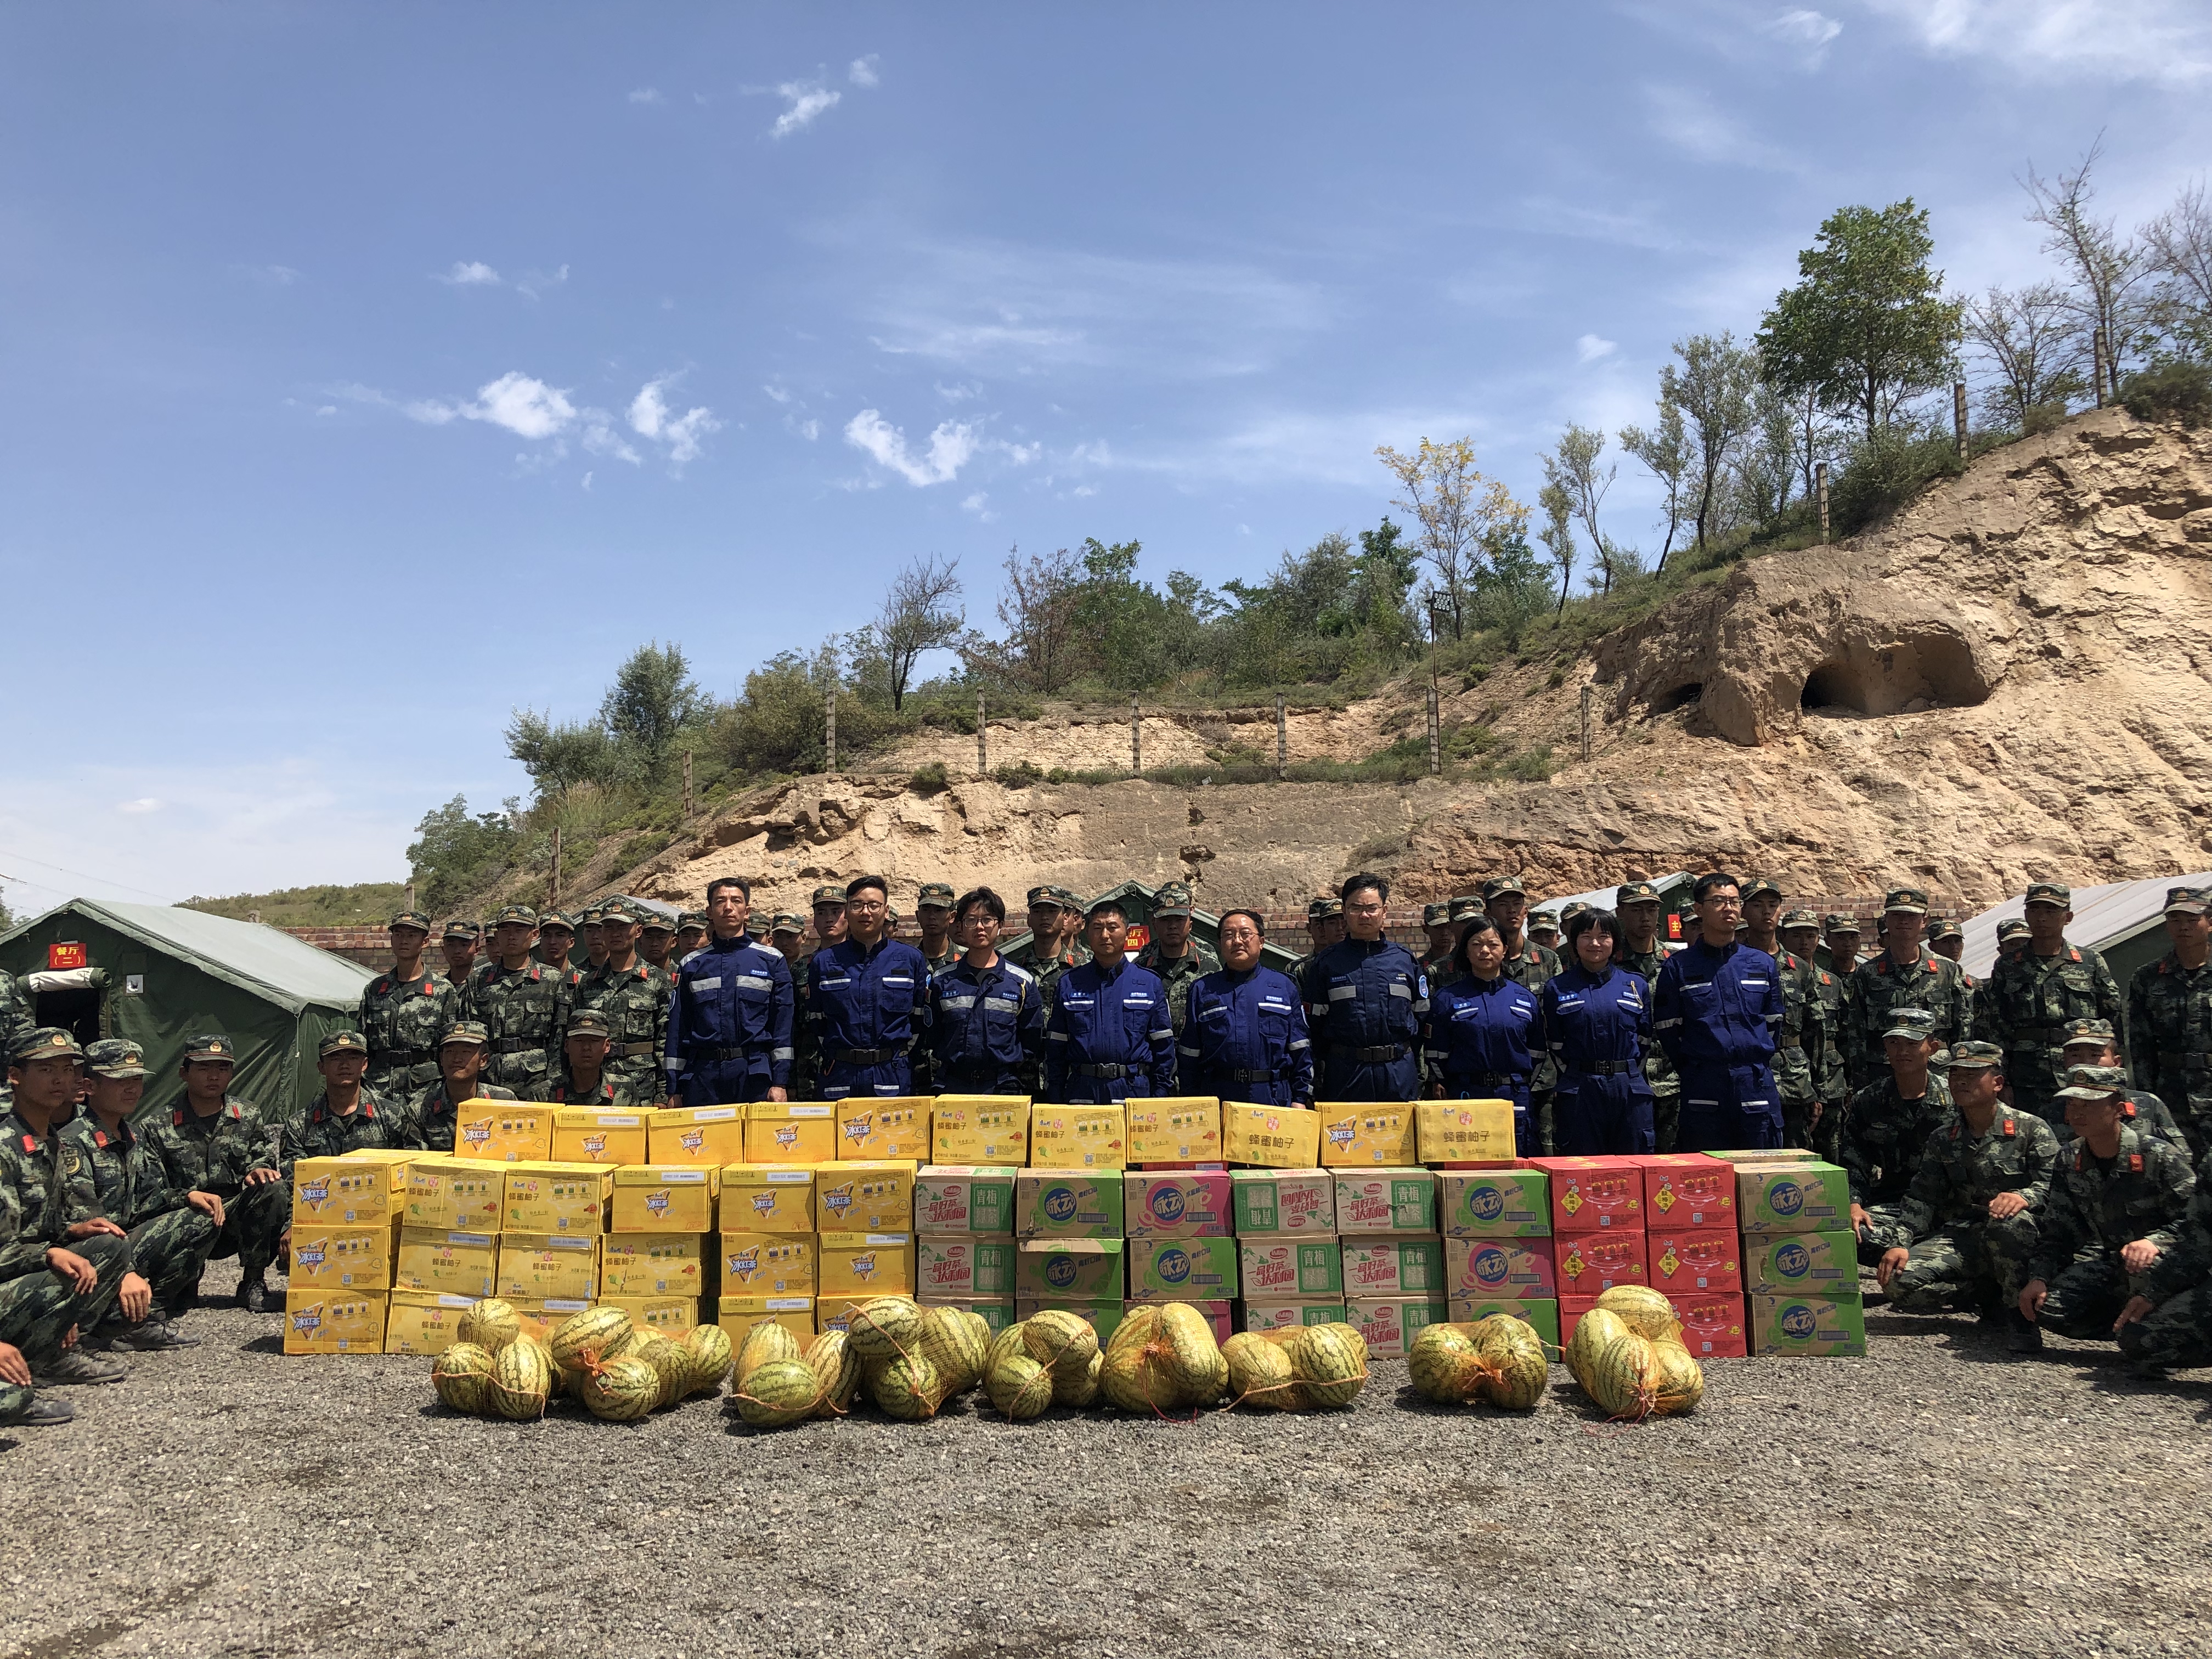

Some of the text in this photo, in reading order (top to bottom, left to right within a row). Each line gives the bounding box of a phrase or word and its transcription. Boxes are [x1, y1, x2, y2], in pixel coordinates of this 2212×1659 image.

[1129, 928, 1143, 937] 厅
[1127, 938, 1145, 947] 四）
[57, 946, 79, 956] 餐厅
[1036, 1130, 1065, 1139] 蜂蜜柚子
[1130, 1124, 1159, 1133] 蜂蜜柚子
[1443, 1130, 1490, 1143] 蜂蜜柚子
[1249, 1134, 1294, 1149] 蜂蜜柚子
[977, 1189, 997, 1205] 青梅
[1281, 1189, 1314, 1206] 达利园
[1398, 1186, 1419, 1202] 青梅
[1771, 1188, 1802, 1209] 脉动
[1046, 1193, 1076, 1215] 脉动
[1154, 1192, 1183, 1214] 脉动
[1341, 1197, 1379, 1210] 一品好茶
[1471, 1192, 1503, 1217] 脉动
[934, 1206, 967, 1222] 达利园
[1251, 1209, 1272, 1225] 青梅
[1356, 1204, 1389, 1221] 达利园
[605, 1257, 636, 1266] 蜂蜜柚子
[980, 1249, 1001, 1266] 青梅
[1304, 1249, 1325, 1266] 青梅
[1405, 1247, 1426, 1264] 青梅
[1778, 1250, 1809, 1271] 脉动
[923, 1259, 962, 1273] 一品好茶
[1047, 1260, 1075, 1281] 脉动
[1159, 1254, 1189, 1278] 脉动
[1246, 1261, 1284, 1276] 一品好茶
[1348, 1258, 1386, 1273] 一品好茶
[1476, 1254, 1507, 1276] 脉动
[937, 1267, 970, 1283] 达利园
[1261, 1268, 1295, 1285] 达利园
[1363, 1266, 1396, 1283] 达利园
[1409, 1309, 1430, 1325] 青梅
[1784, 1312, 1815, 1332] 脉动
[1366, 1328, 1400, 1344] 达利园
